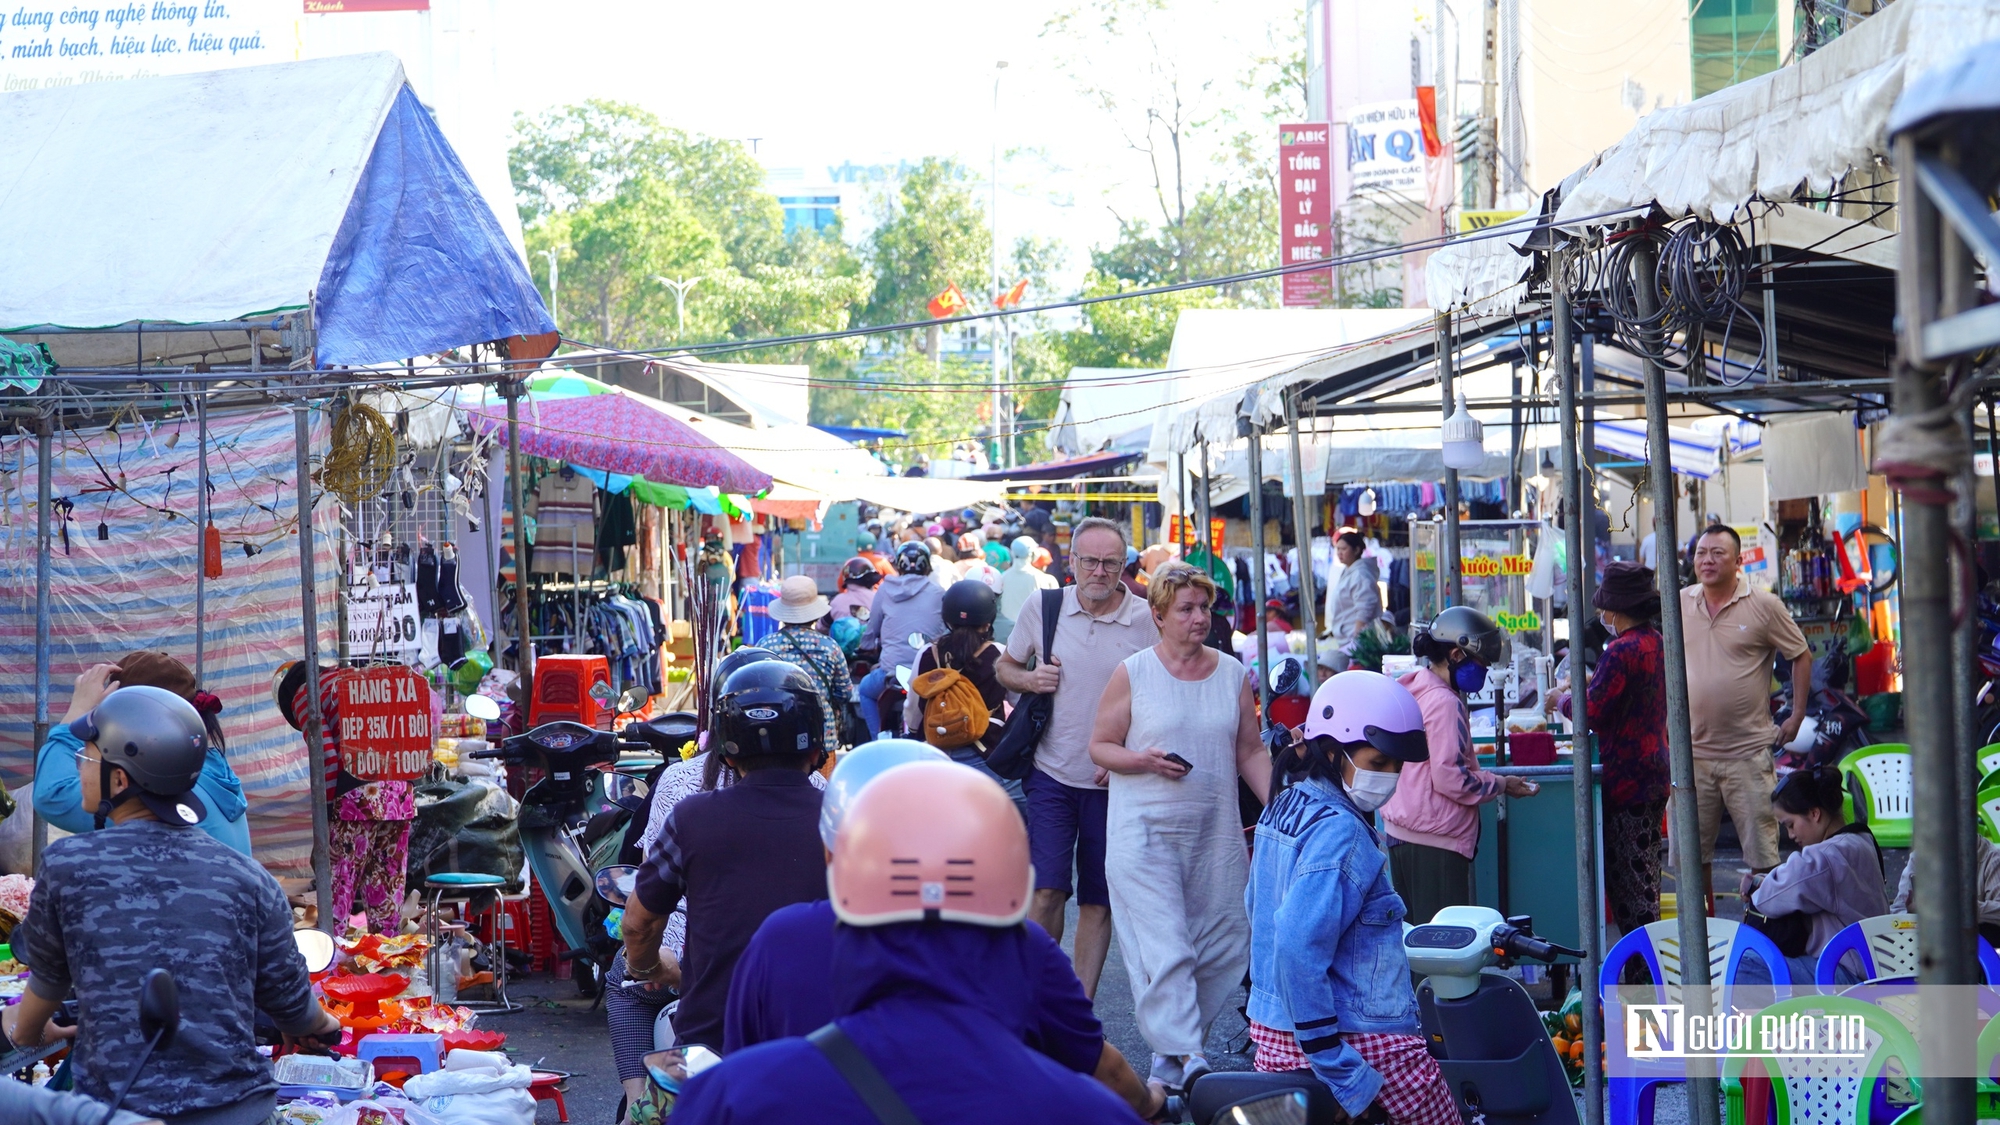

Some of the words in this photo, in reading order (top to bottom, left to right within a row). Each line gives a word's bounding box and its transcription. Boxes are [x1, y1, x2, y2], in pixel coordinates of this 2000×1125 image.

[12, 6, 54, 33] dụng
[60, 8, 99, 31] công
[105, 2, 146, 30] nghệ
[151, 1, 198, 27] thông
[12, 38, 53, 58] minh
[59, 37, 104, 60] bạch,
[110, 36, 146, 58] hiệu
[151, 34, 182, 57] lực,
[188, 32, 225, 55] hiệu
[229, 30, 266, 55] quả.
[1296, 131, 1327, 143] ABIC
[1288, 151, 1321, 171] TỔNG
[1294, 178, 1317, 195] ĐẠI
[1497, 611, 1539, 634] Sạch
[348, 675, 392, 704] HÀNG
[342, 712, 364, 740] DÉP
[367, 716, 389, 739] 35K
[399, 715, 405, 738] 1
[409, 709, 429, 738] ĐÔI
[357, 747, 380, 775] ĐÔI
[394, 749, 429, 774] 100K
